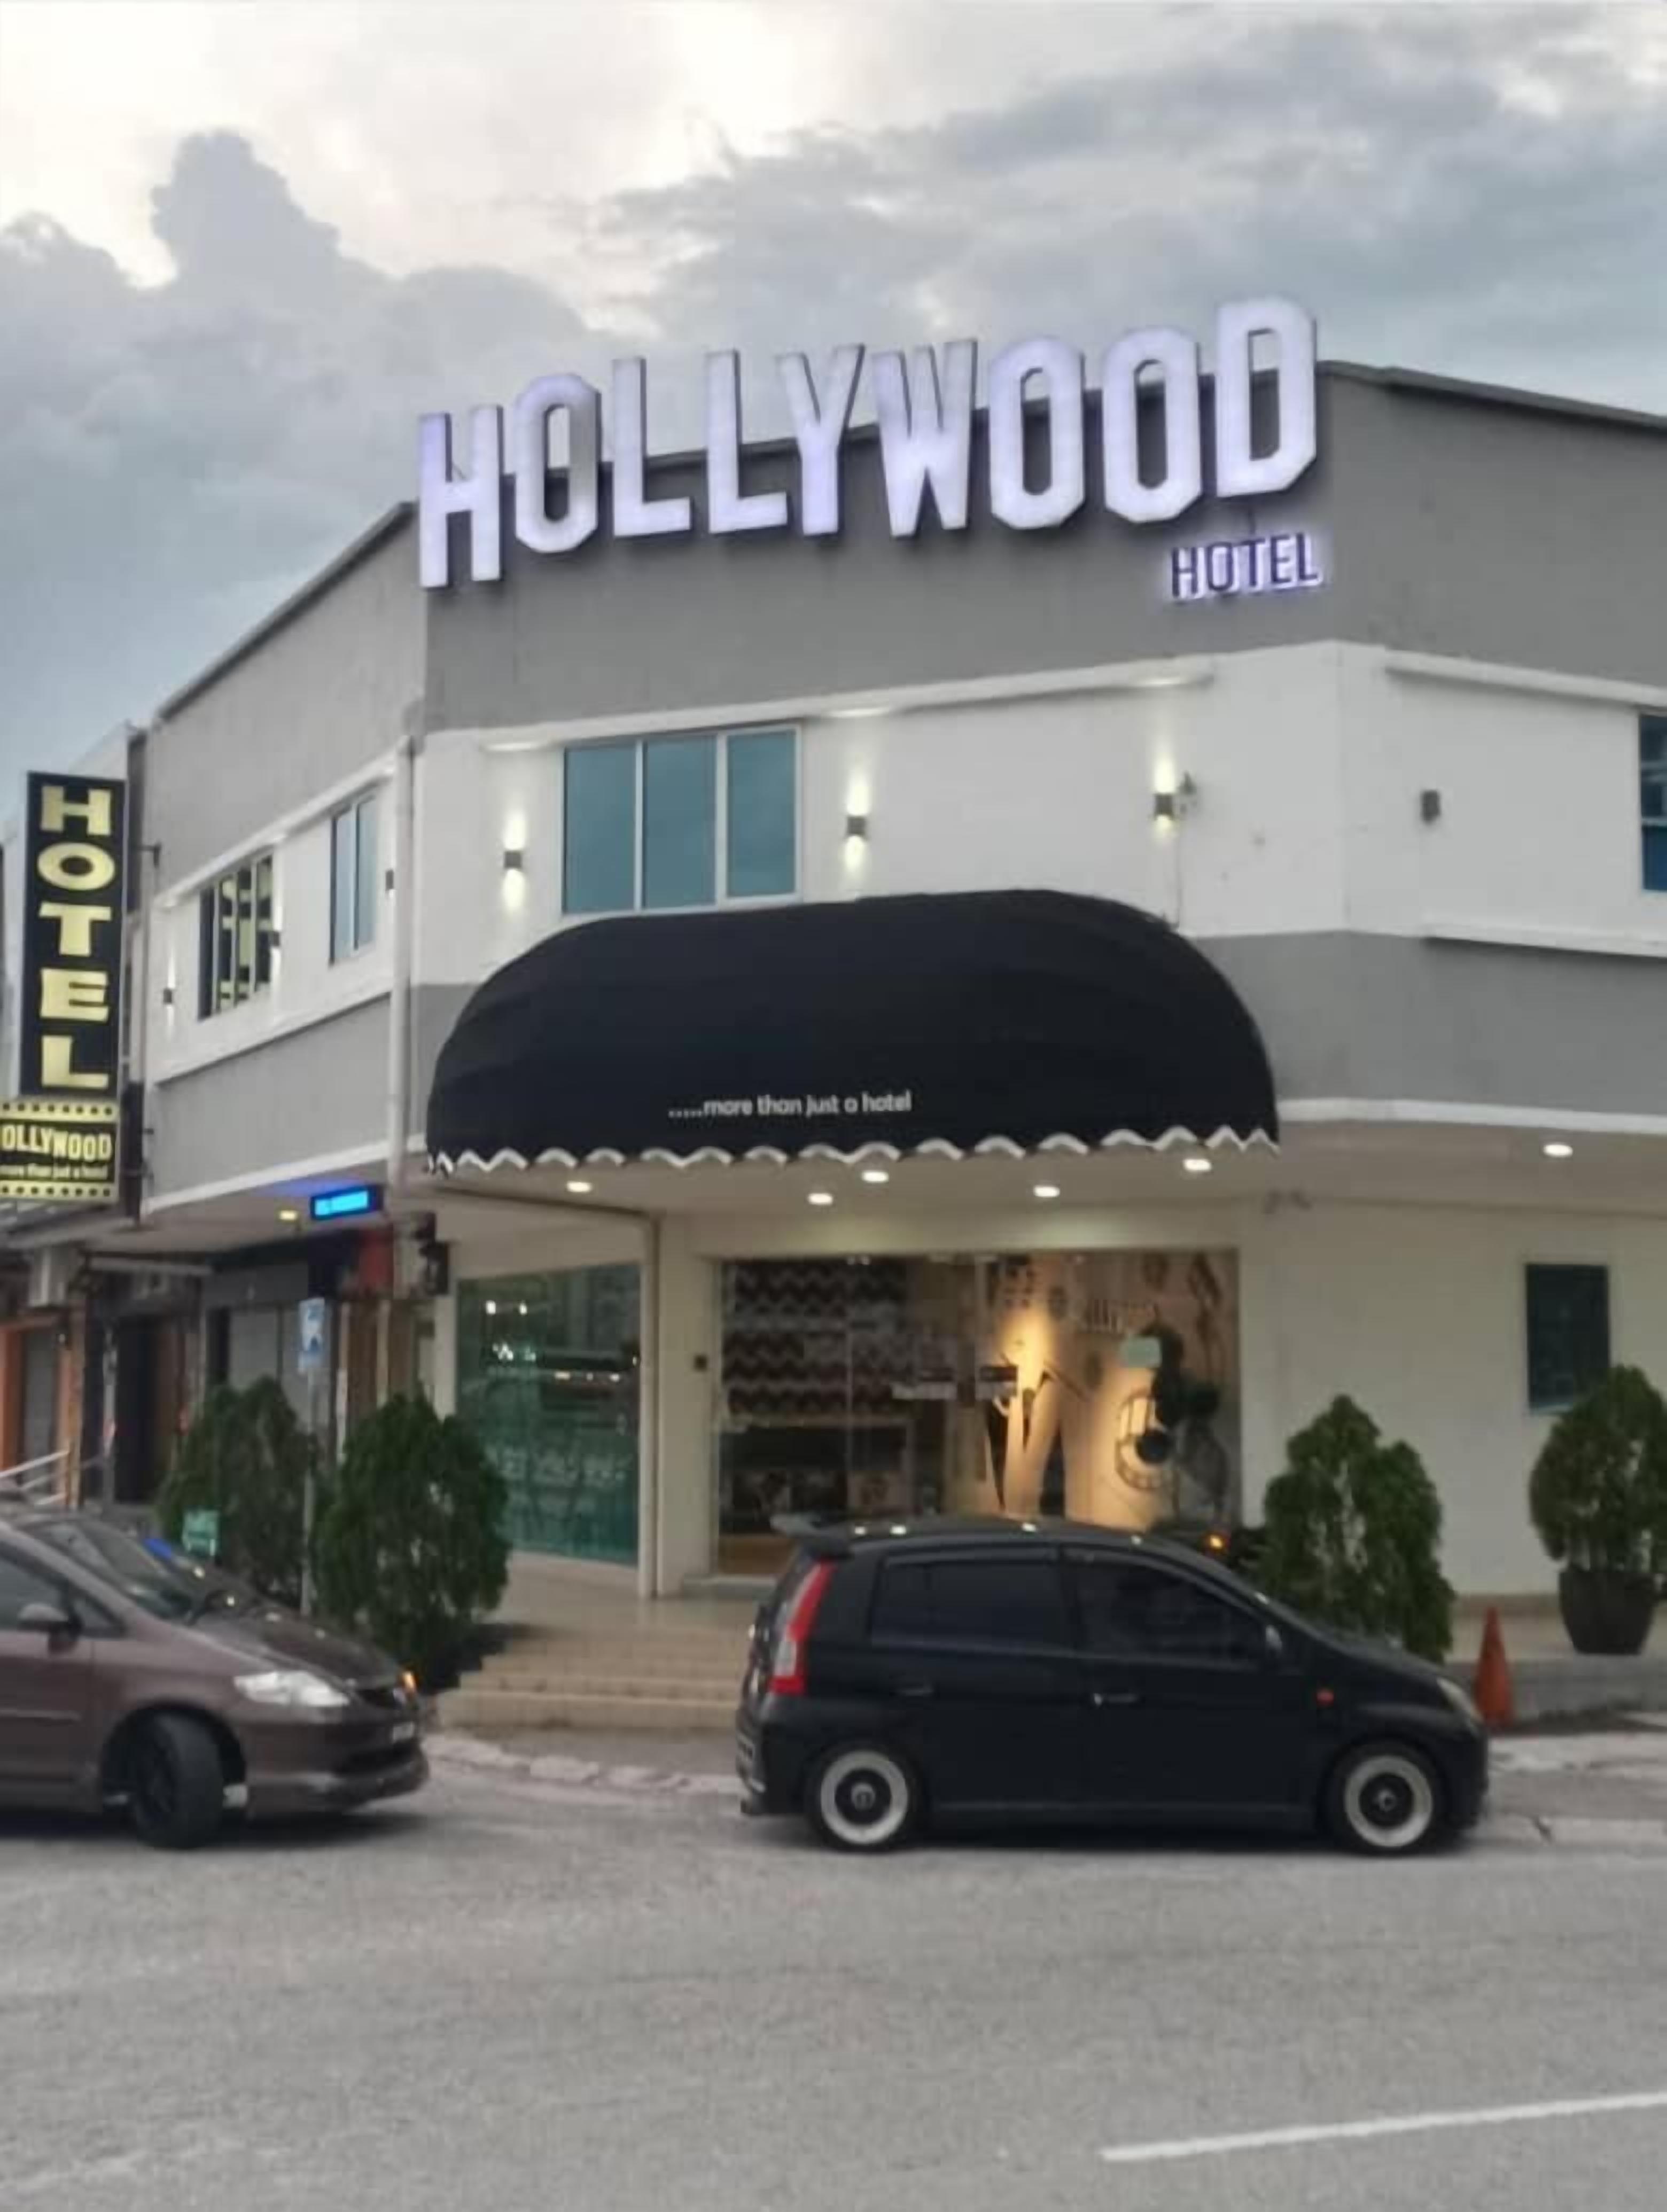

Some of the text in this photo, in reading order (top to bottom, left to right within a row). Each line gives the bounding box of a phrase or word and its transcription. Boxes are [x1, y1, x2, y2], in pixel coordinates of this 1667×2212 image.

[419, 297, 1317, 588] HOLLYWOOD
[1172, 532, 1321, 598] HOTEL
[37, 785, 115, 1088] HOTEL
[757, 1094, 801, 1115] than
[806, 1094, 839, 1118] just
[862, 1090, 912, 1112] hotel
[1, 1124, 113, 1162] OLLYWOOD
